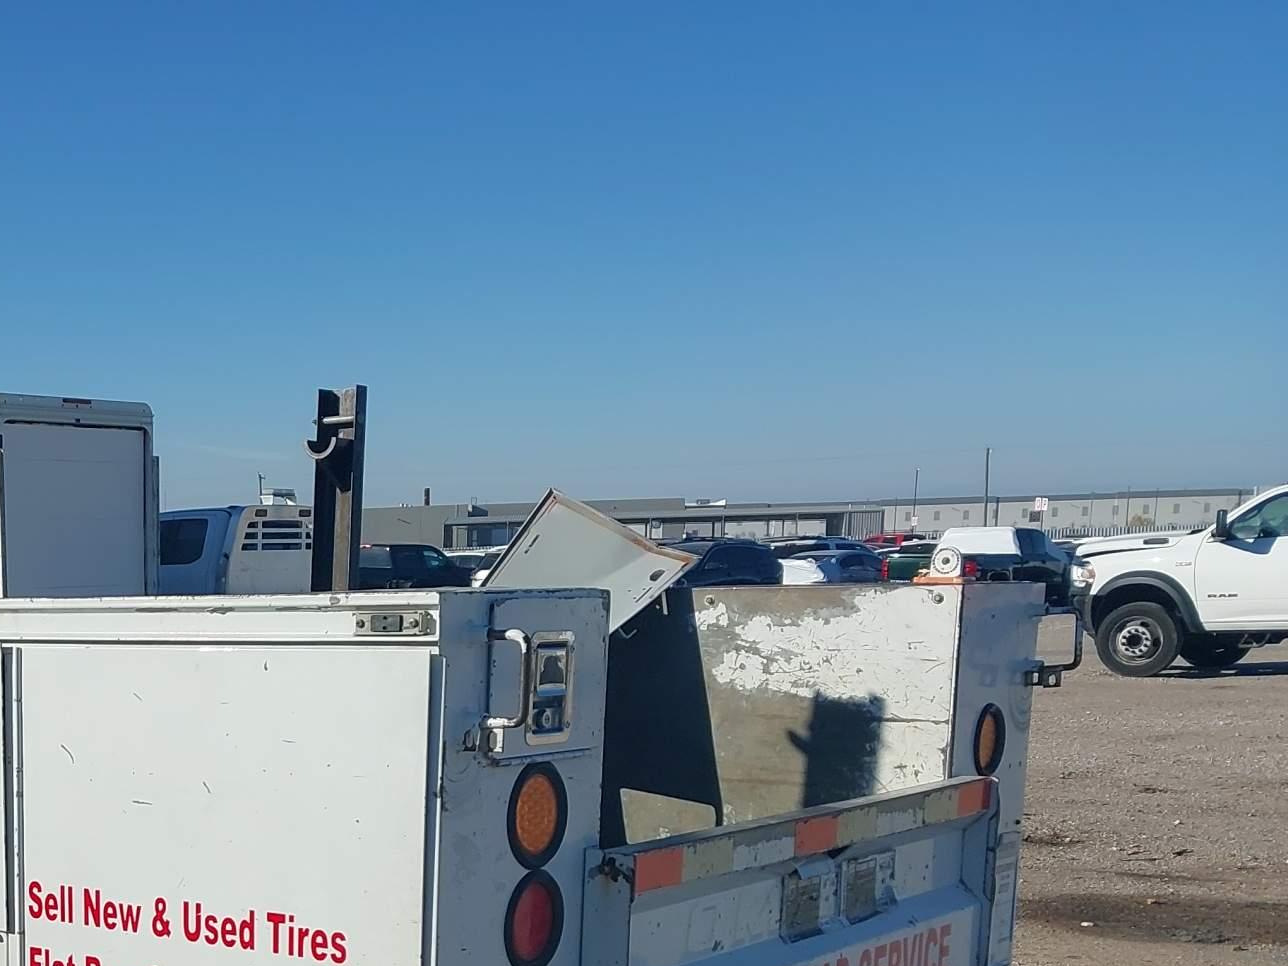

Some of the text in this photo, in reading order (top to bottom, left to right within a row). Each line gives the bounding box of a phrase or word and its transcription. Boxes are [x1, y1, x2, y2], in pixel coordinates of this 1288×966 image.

[28, 881, 347, 964] Sell New & Used Tires
